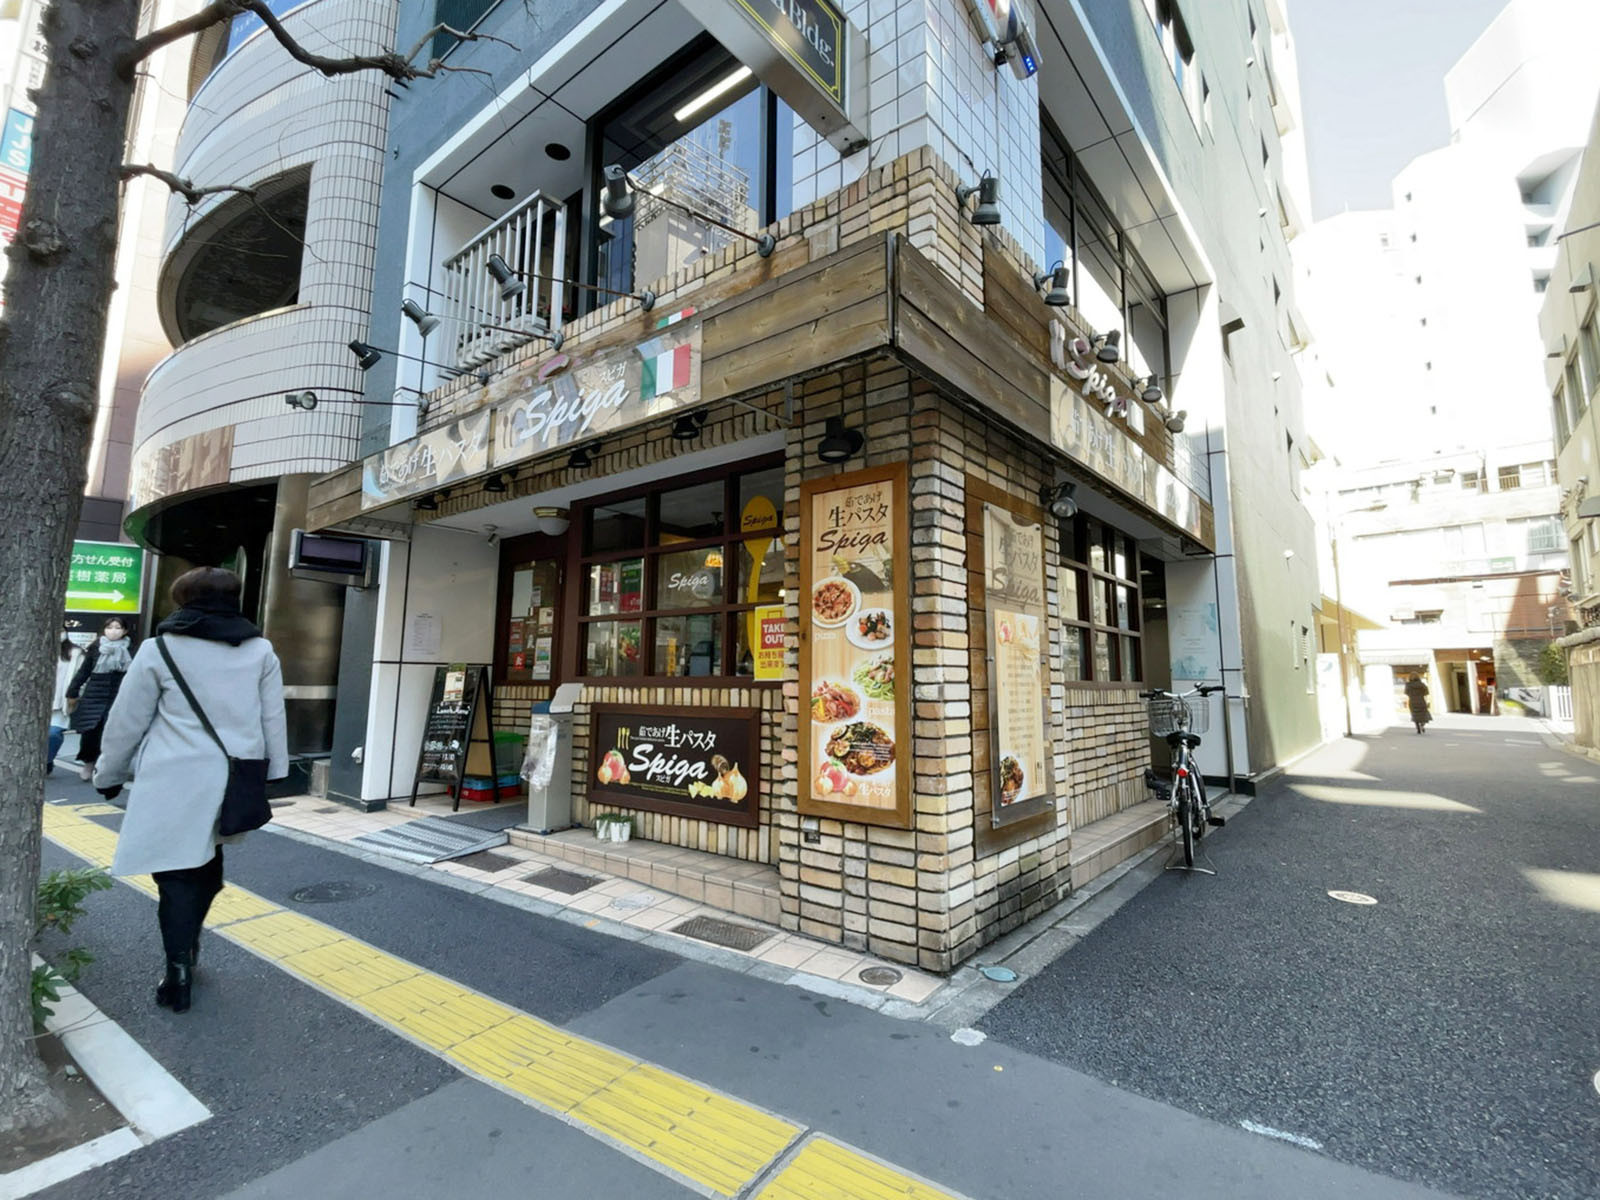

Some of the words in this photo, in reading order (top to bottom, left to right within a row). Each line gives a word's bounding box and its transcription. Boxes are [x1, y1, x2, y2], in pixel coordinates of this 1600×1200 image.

[519, 379, 630, 443] Spiga
[828, 503, 889, 528] 生パスタ
[816, 529, 889, 556] Spiga
[69, 569, 127, 584] 樹薬局
[668, 572, 709, 591] Spiga
[765, 634, 785, 645] OUT
[628, 743, 708, 786] Spiga
